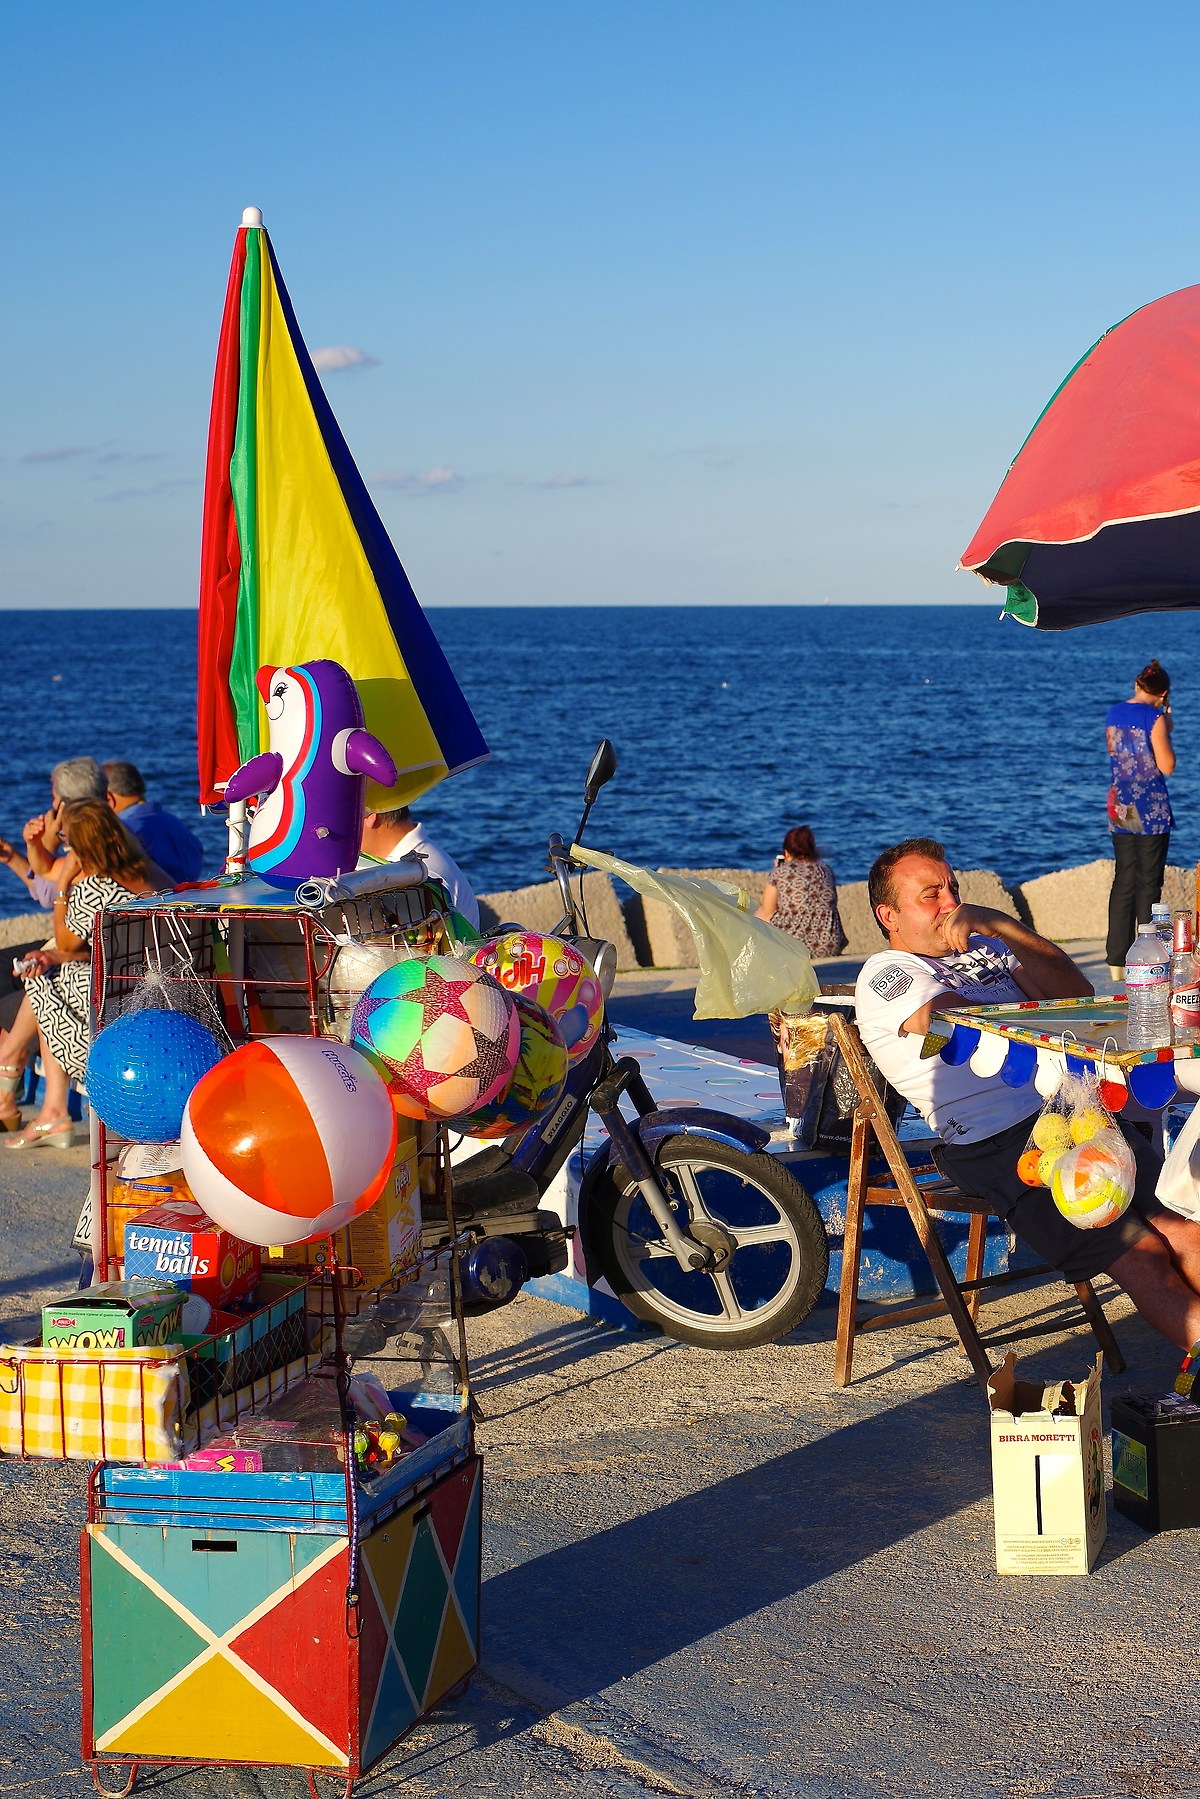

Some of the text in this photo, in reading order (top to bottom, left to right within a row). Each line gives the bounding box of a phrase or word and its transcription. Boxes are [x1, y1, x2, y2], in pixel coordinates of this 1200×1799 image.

[875, 970, 904, 992] 1982
[321, 1051, 357, 1093] HUGGIES
[548, 1100, 574, 1137] PIAGGIO
[128, 1231, 192, 1257] tennis
[154, 1253, 210, 1275] balls
[236, 1250, 254, 1279] GUM
[48, 1327, 125, 1348] WOW!
[1031, 1434, 1076, 1442] MORETTI
